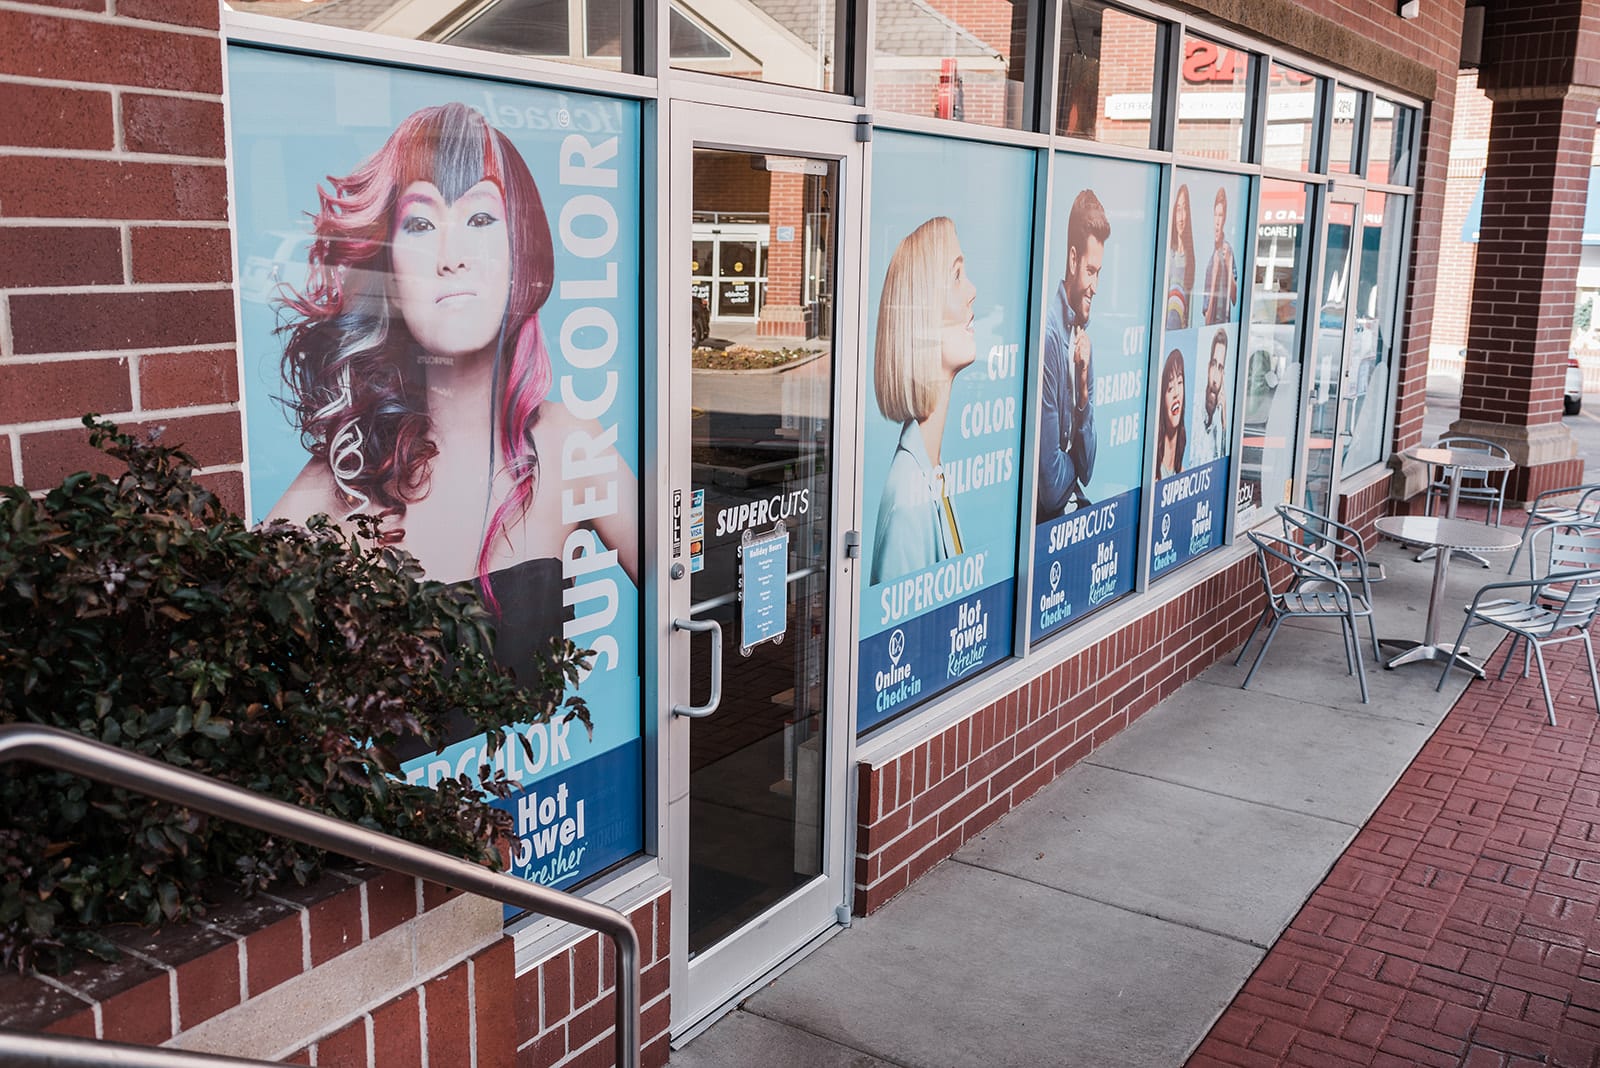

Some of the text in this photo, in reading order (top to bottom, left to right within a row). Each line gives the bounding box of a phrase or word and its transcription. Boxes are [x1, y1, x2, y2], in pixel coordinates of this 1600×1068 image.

[1123, 325, 1145, 356] CUT
[987, 343, 1019, 381] CUT
[1095, 369, 1142, 407] BEARDS
[559, 134, 619, 684] SUPERCOLOR
[960, 396, 1016, 439] COLOR
[1109, 412, 1139, 447] FADE
[1160, 468, 1211, 508] SUPERCUTS
[673, 494, 681, 544] PULL
[716, 488, 809, 537] SUPERCUTS
[1048, 503, 1117, 554] SUPERCUTS
[1191, 510, 1213, 537] Towel
[1196, 500, 1209, 520] Hot
[690, 528, 702, 537] VISA
[749, 546, 768, 559] Holiday
[1091, 552, 1118, 584] Towel
[1097, 540, 1114, 566] Hot
[880, 553, 985, 626] SUPERCOLOR
[1040, 589, 1065, 612] Online
[950, 612, 988, 655] Towel
[958, 599, 982, 632] Hot
[1040, 600, 1072, 630] Check-in
[875, 663, 912, 693] Online
[946, 643, 987, 679] Refresher
[876, 675, 922, 713] Check-in
[518, 782, 569, 838] Hot
[510, 799, 585, 872] owel
